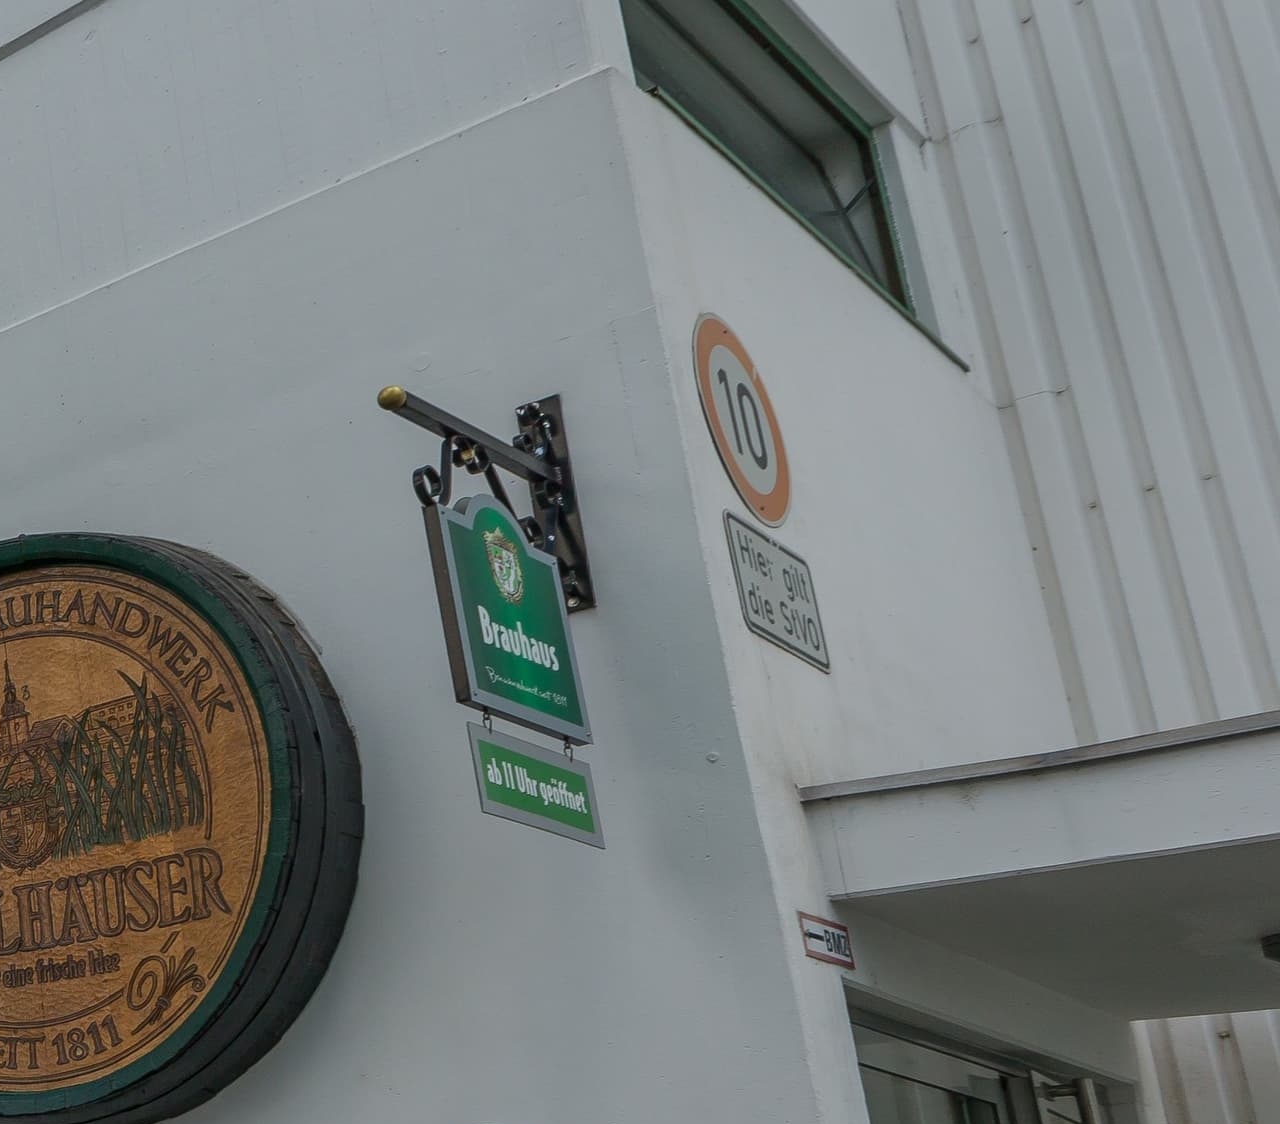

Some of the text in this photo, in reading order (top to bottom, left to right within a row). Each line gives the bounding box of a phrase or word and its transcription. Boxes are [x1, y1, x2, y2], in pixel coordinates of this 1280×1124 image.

[717, 366, 768, 471] 10
[782, 564, 811, 604] gilt
[477, 604, 560, 672] Brauhaus
[747, 583, 820, 652] die StVO
[486, 757, 588, 814] ab 11 Uhr geöffnet
[2, 964, 34, 989] eine
[35, 953, 87, 985] frische
[87, 948, 121, 977] Idee
[823, 928, 851, 958] BMZ
[51, 1014, 124, 1066] 1811
